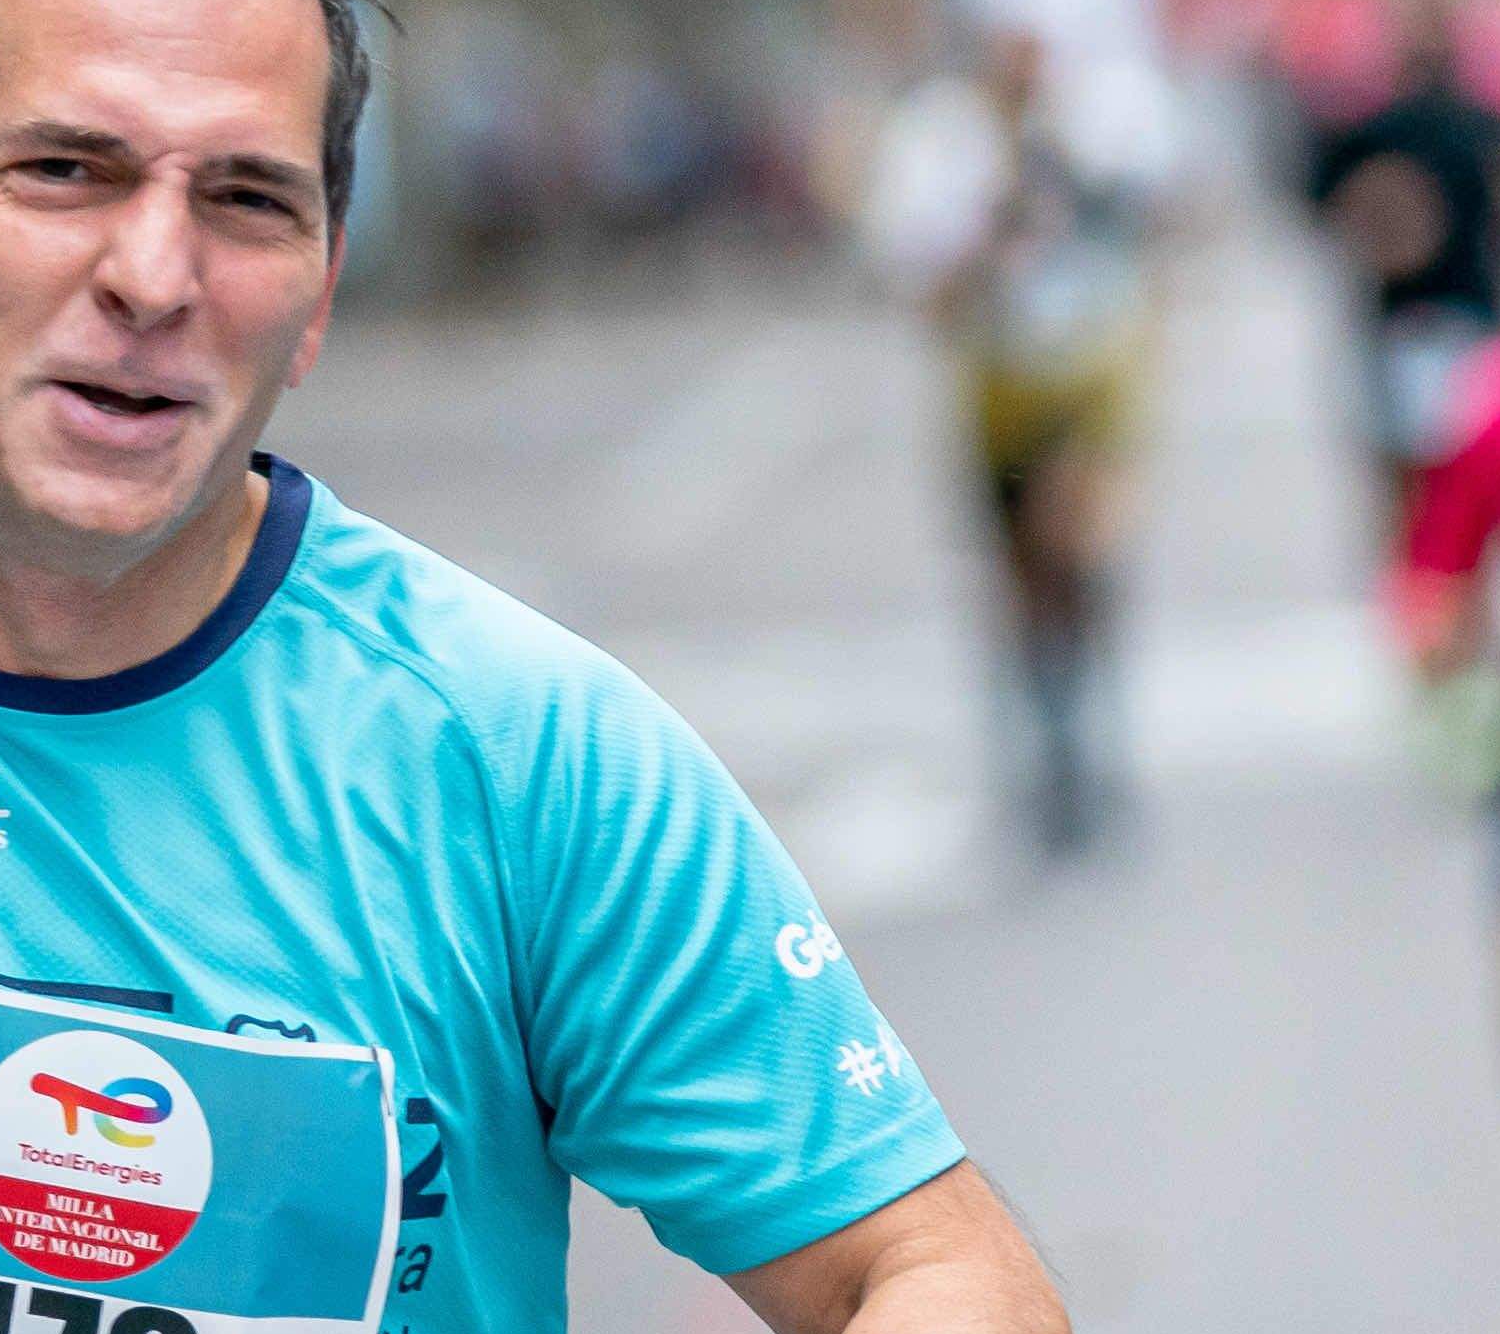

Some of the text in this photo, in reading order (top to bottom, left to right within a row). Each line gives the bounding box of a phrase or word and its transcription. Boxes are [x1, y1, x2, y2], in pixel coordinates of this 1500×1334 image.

[18, 1142, 163, 1186] TotalEnergies
[46, 1193, 115, 1221] MILLA
[13, 1230, 136, 1267] DE MADRID
